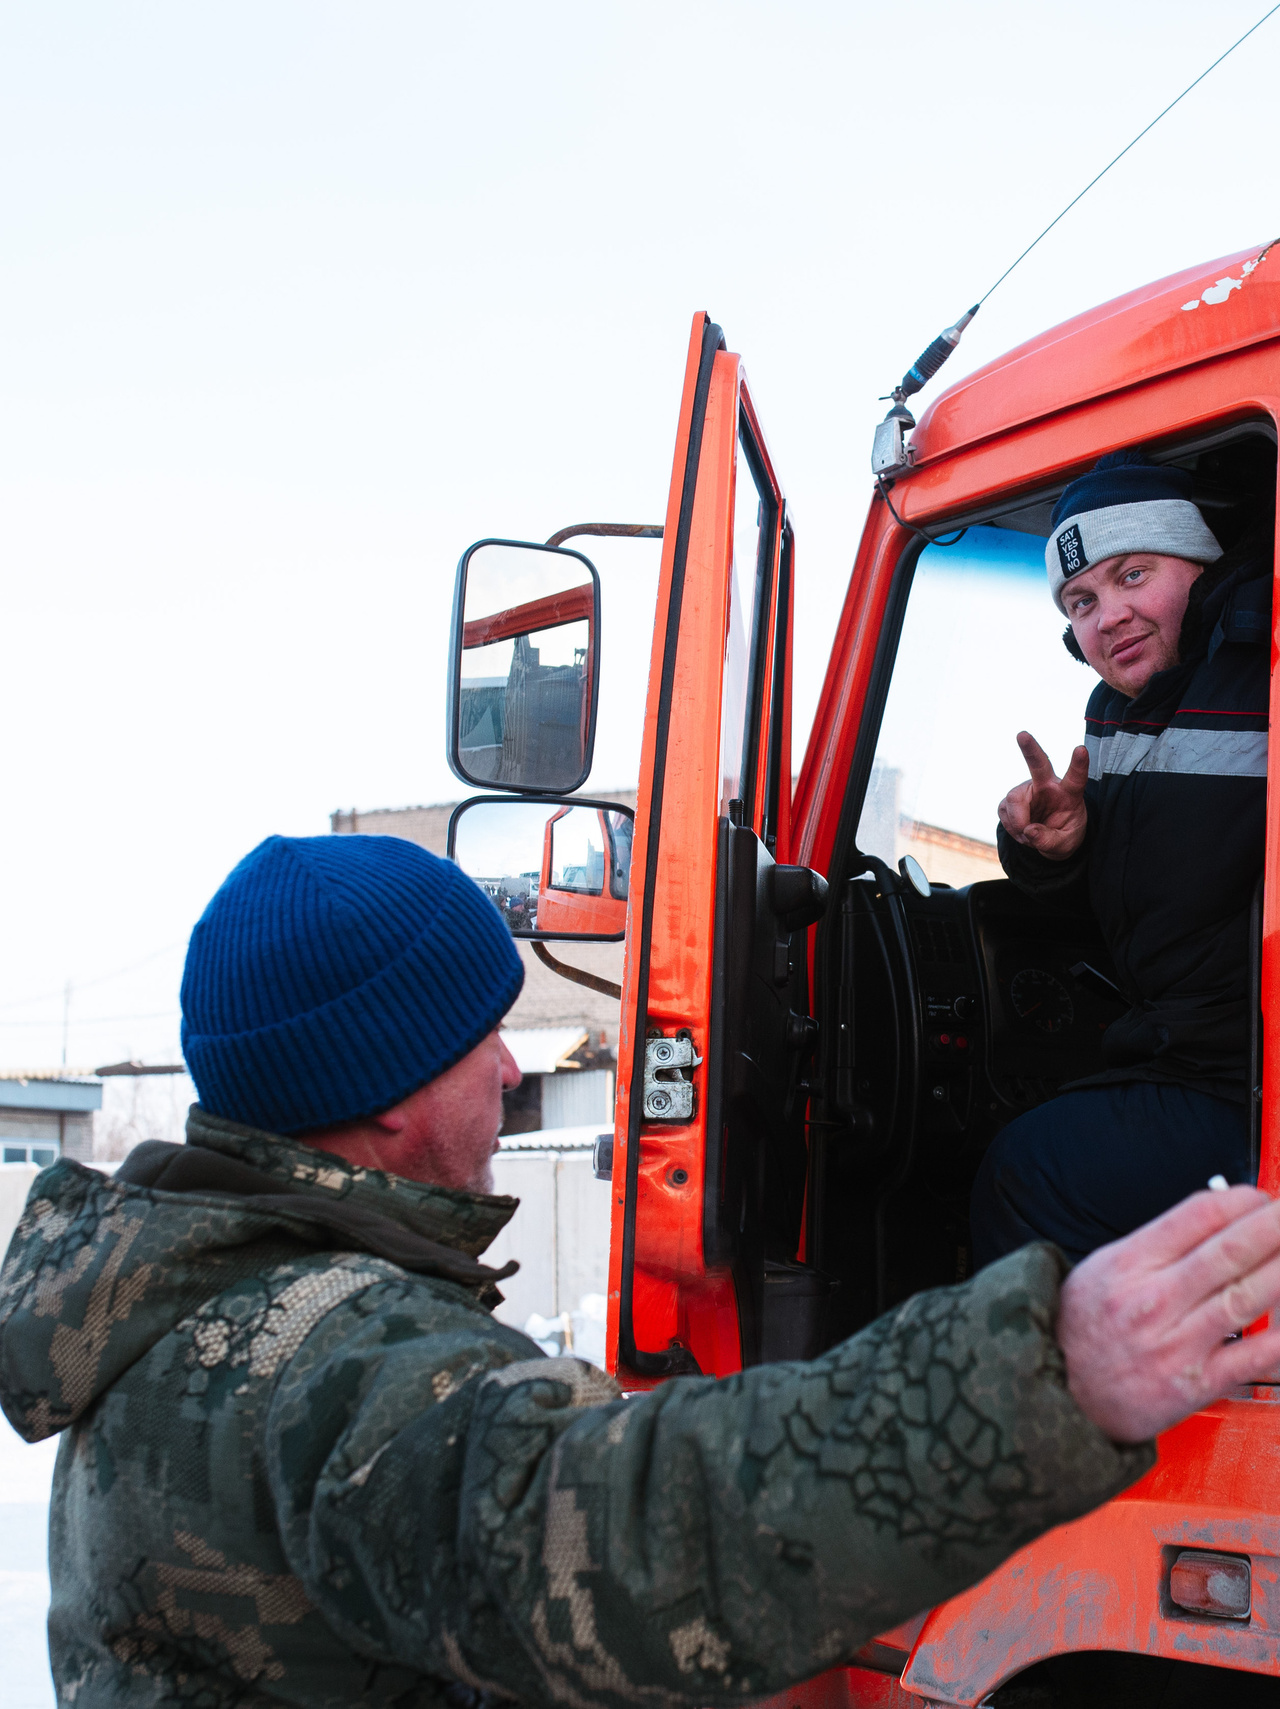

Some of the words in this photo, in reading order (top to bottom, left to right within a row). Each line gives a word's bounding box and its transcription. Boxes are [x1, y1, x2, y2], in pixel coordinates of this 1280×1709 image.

[1060, 528, 1075, 546] SAY
[1062, 538, 1078, 554] YES
[1065, 549, 1078, 561] TO
[1067, 558, 1080, 572] NO
